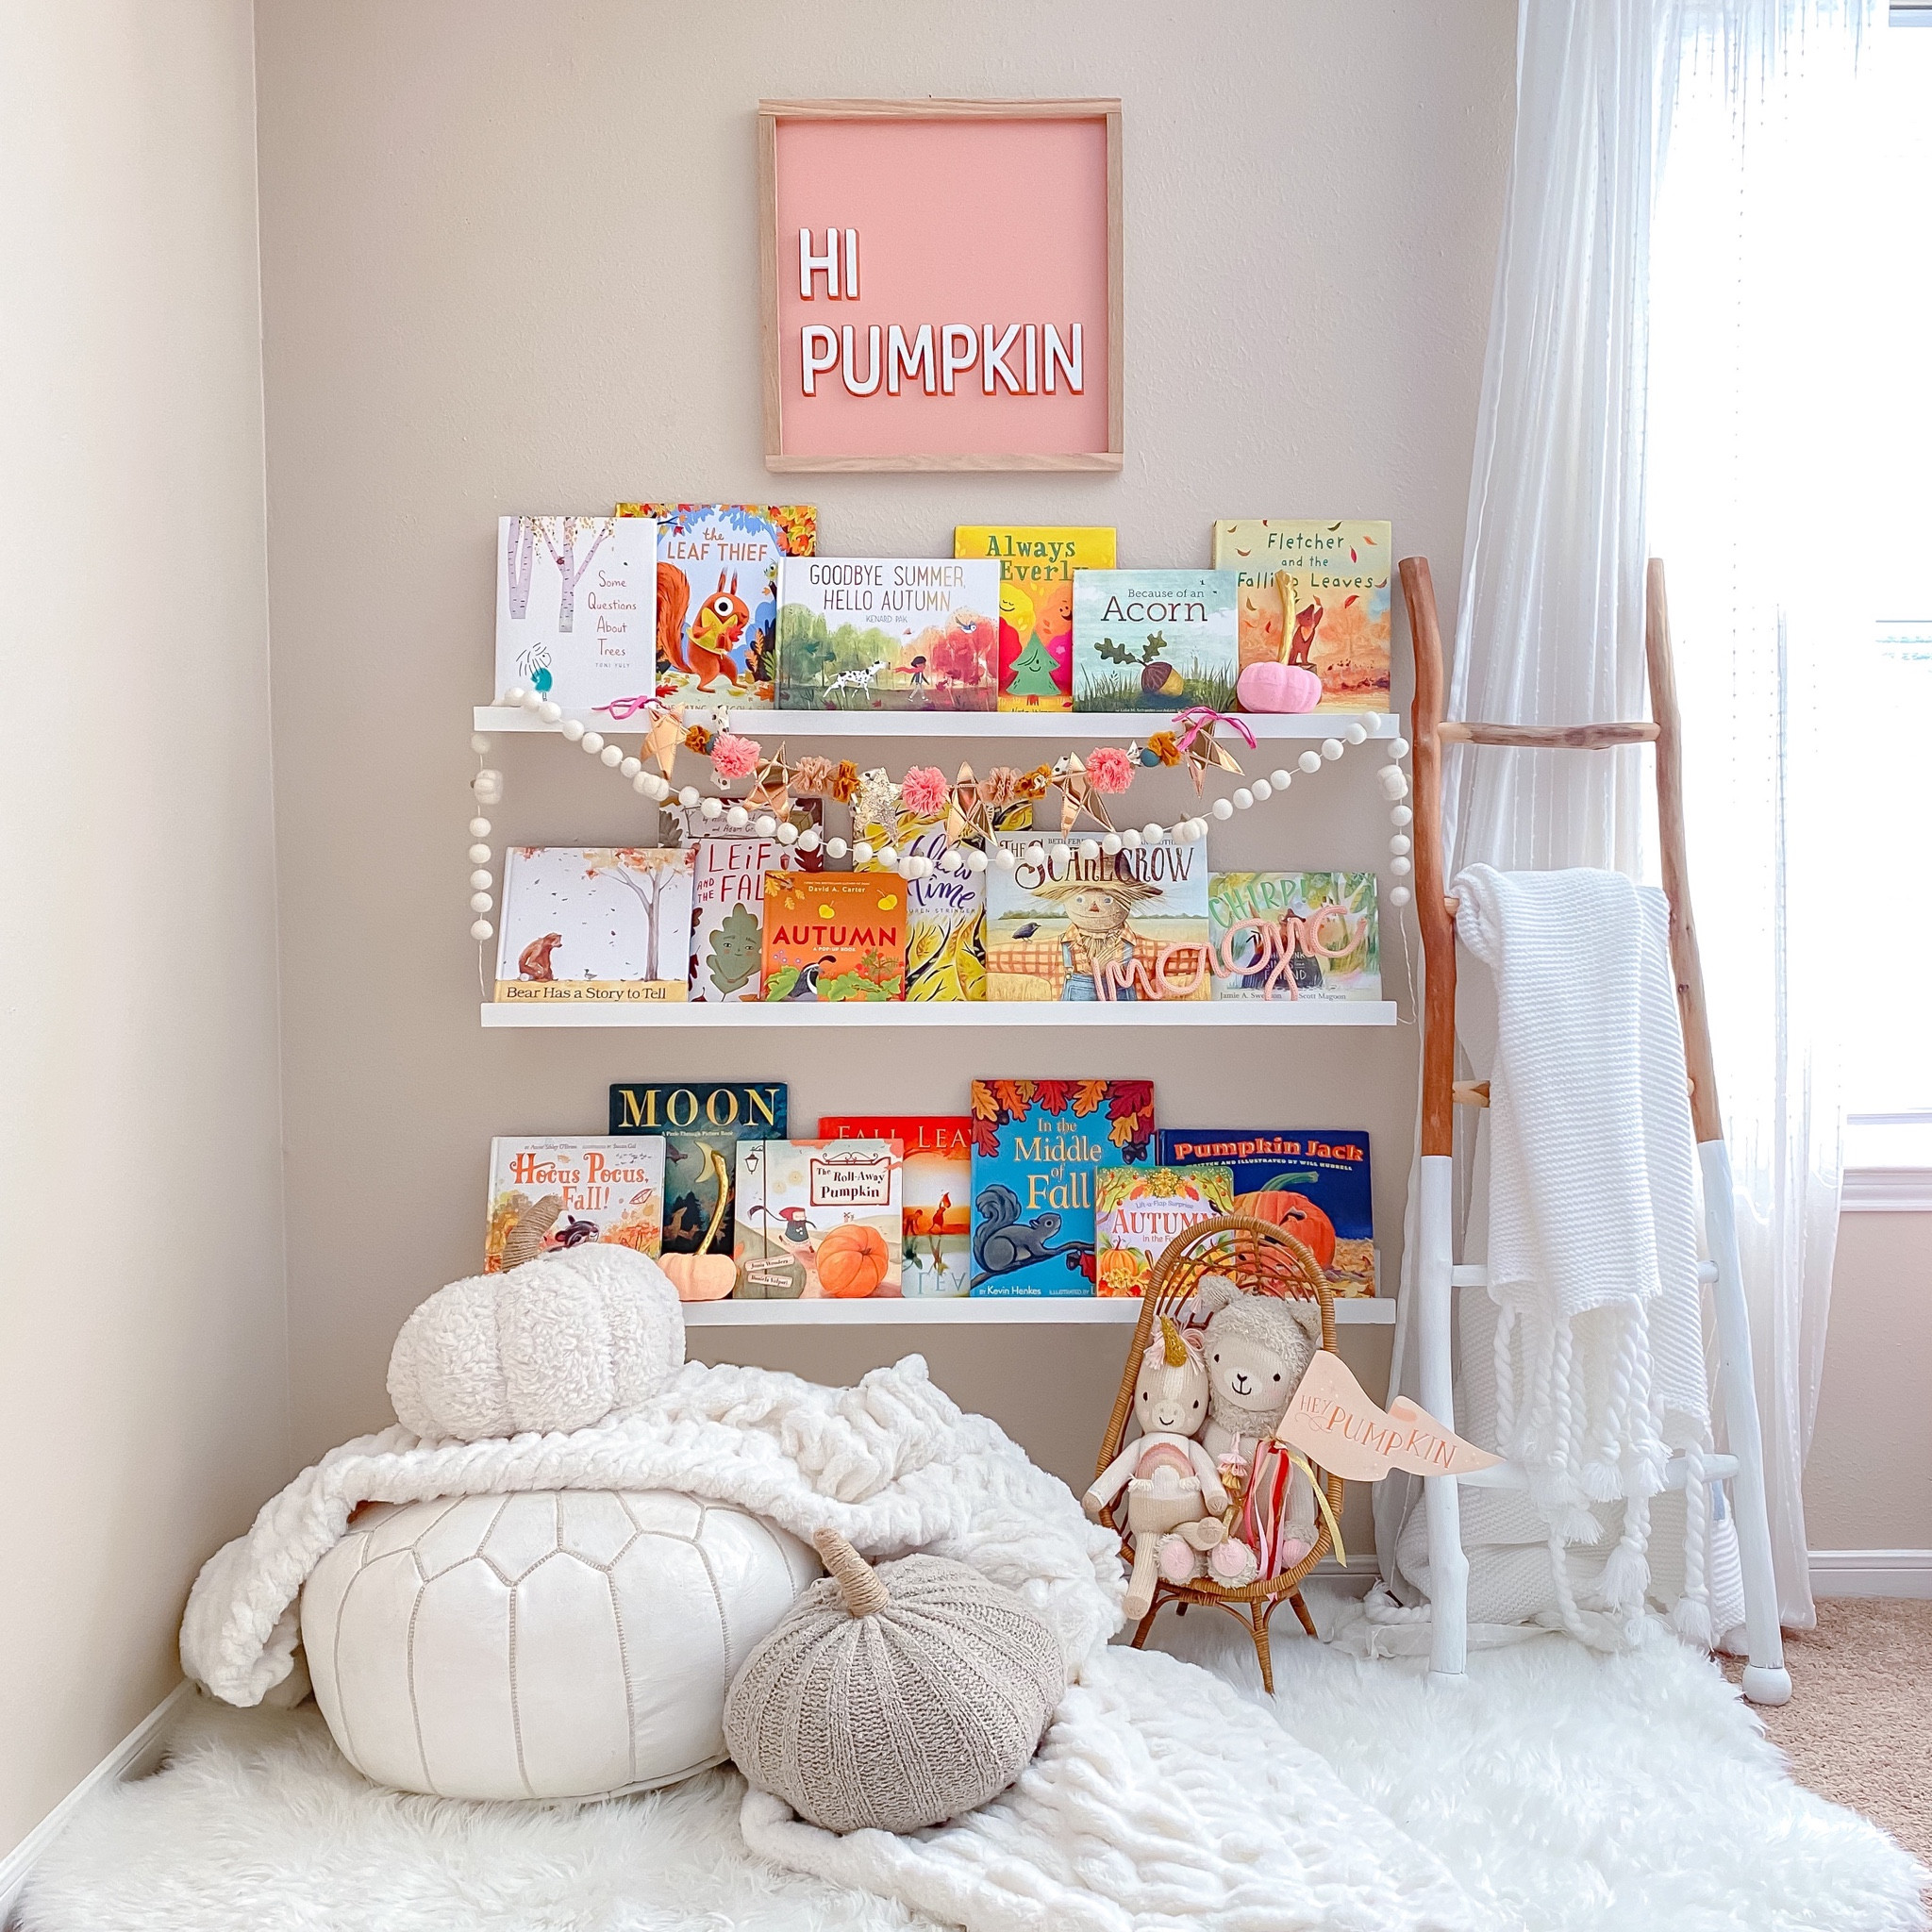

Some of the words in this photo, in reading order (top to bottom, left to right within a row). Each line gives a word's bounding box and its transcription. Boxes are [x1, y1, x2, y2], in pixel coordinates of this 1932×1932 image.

[799, 227, 859, 300] HI
[801, 323, 1084, 396] PUMPKIN
[703, 527, 724, 541] the
[1268, 533, 1345, 549] Fletcher
[667, 541, 708, 560] LEAF
[718, 543, 768, 562] THIEF
[985, 535, 1075, 563] Always
[1000, 560, 1089, 581] Everl
[1281, 556, 1303, 567] and
[1309, 556, 1329, 567] the
[598, 570, 626, 588] Some
[809, 564, 883, 586] GOODBYE
[894, 566, 966, 589] SUMMER,
[1310, 573, 1374, 588] Leaves
[587, 591, 637, 611] Questions
[824, 590, 873, 610] HELLO
[881, 590, 951, 611] AUTUMN
[1128, 589, 1174, 598] Because
[1176, 589, 1188, 598] of
[1100, 595, 1208, 622] Acorn
[596, 616, 627, 634] About
[597, 638, 626, 657] Trees
[1000, 840, 1025, 858] THE
[696, 877, 714, 891] AND
[908, 874, 975, 908] Time
[697, 891, 714, 904] THE
[773, 925, 896, 946] AUTUMN
[507, 987, 541, 998] Bear
[542, 988, 571, 999] Has
[574, 990, 582, 999] a
[586, 988, 624, 1001] Story
[627, 989, 641, 999] to
[642, 989, 666, 999] Tell
[1220, 991, 1240, 1000] Jamie
[1318, 992, 1346, 1001] Magoon
[618, 1089, 779, 1128] MOON
[1038, 1118, 1052, 1132] In
[1057, 1117, 1077, 1133] the
[919, 1125, 971, 1148] LEA
[1014, 1135, 1102, 1162] Middle
[1174, 1136, 1301, 1160] Pumpkin
[1306, 1140, 1364, 1162] Jack
[509, 1152, 580, 1185] Hocus
[583, 1152, 649, 1184] Pocus,
[833, 1172, 885, 1184] Roll-Away
[1051, 1163, 1065, 1182] of
[562, 1186, 610, 1211] Fall!
[821, 1186, 879, 1201] Pumpkin
[1026, 1173, 1091, 1209] Fall
[987, 1285, 1009, 1295] Kevin
[1011, 1286, 1041, 1295] Henkes
[1300, 1395, 1333, 1413] HEY
[1325, 1406, 1457, 1469] PUMPKIN
